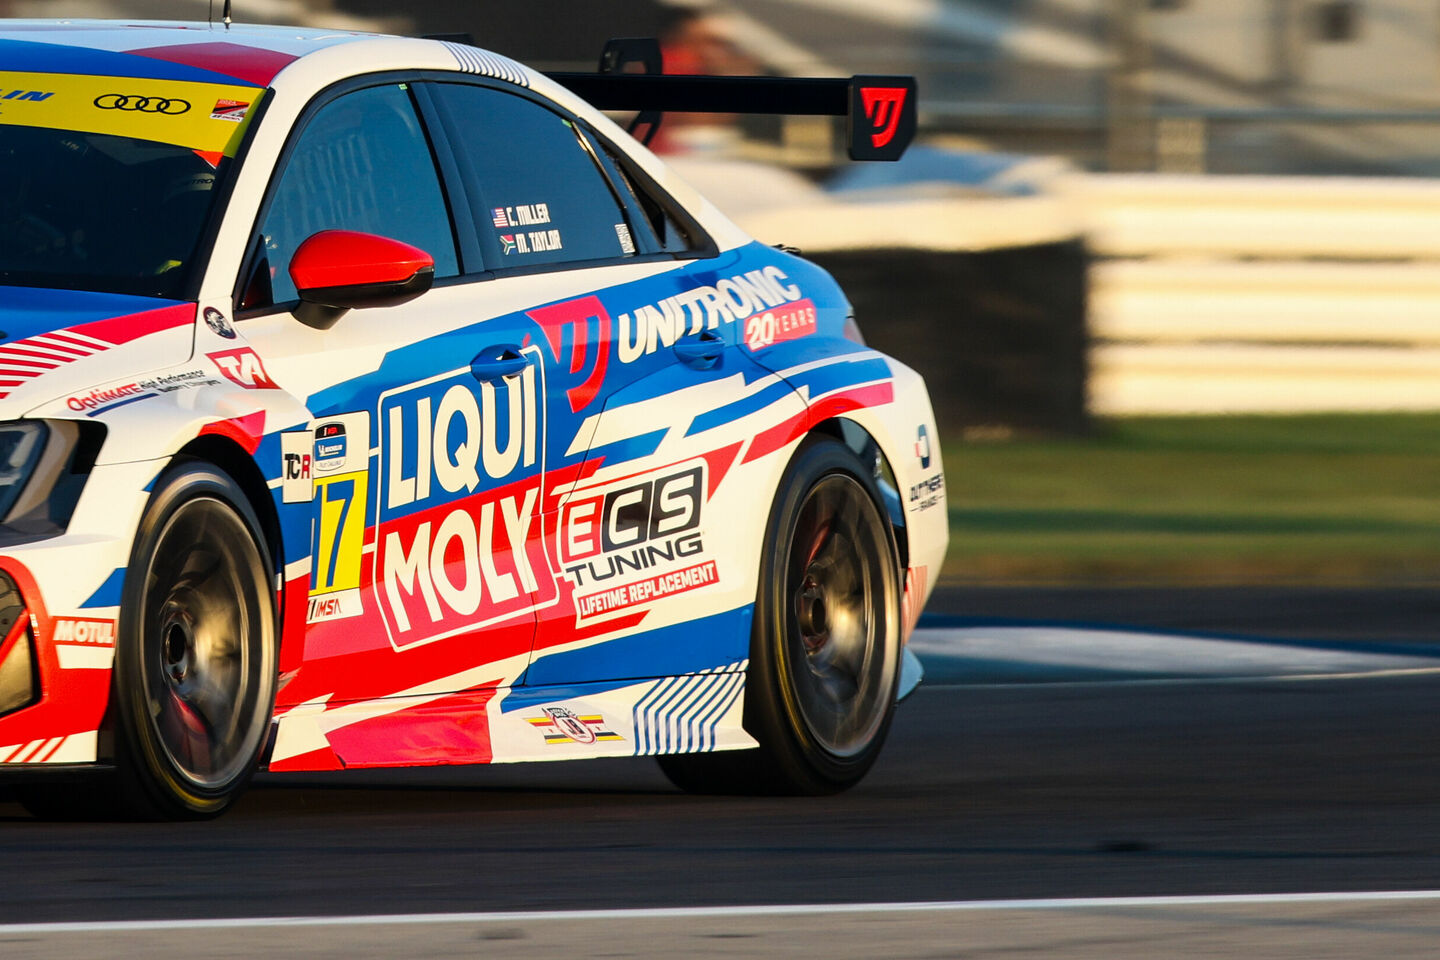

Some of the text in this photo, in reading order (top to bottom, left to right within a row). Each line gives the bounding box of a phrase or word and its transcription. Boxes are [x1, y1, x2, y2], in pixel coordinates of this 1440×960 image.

[516, 203, 551, 226] MILLER
[529, 229, 563, 253] TAYLOR
[618, 266, 801, 364] UNITRONIC
[746, 307, 816, 350] 20 YEARS
[388, 364, 536, 509] LIQUI
[284, 453, 311, 480] TCR
[310, 479, 355, 590] 17
[567, 474, 695, 557] ECS
[384, 487, 539, 633] MOLY
[566, 532, 703, 586] TUNING
[581, 563, 715, 616] LIFETIME REPLACEMENT
